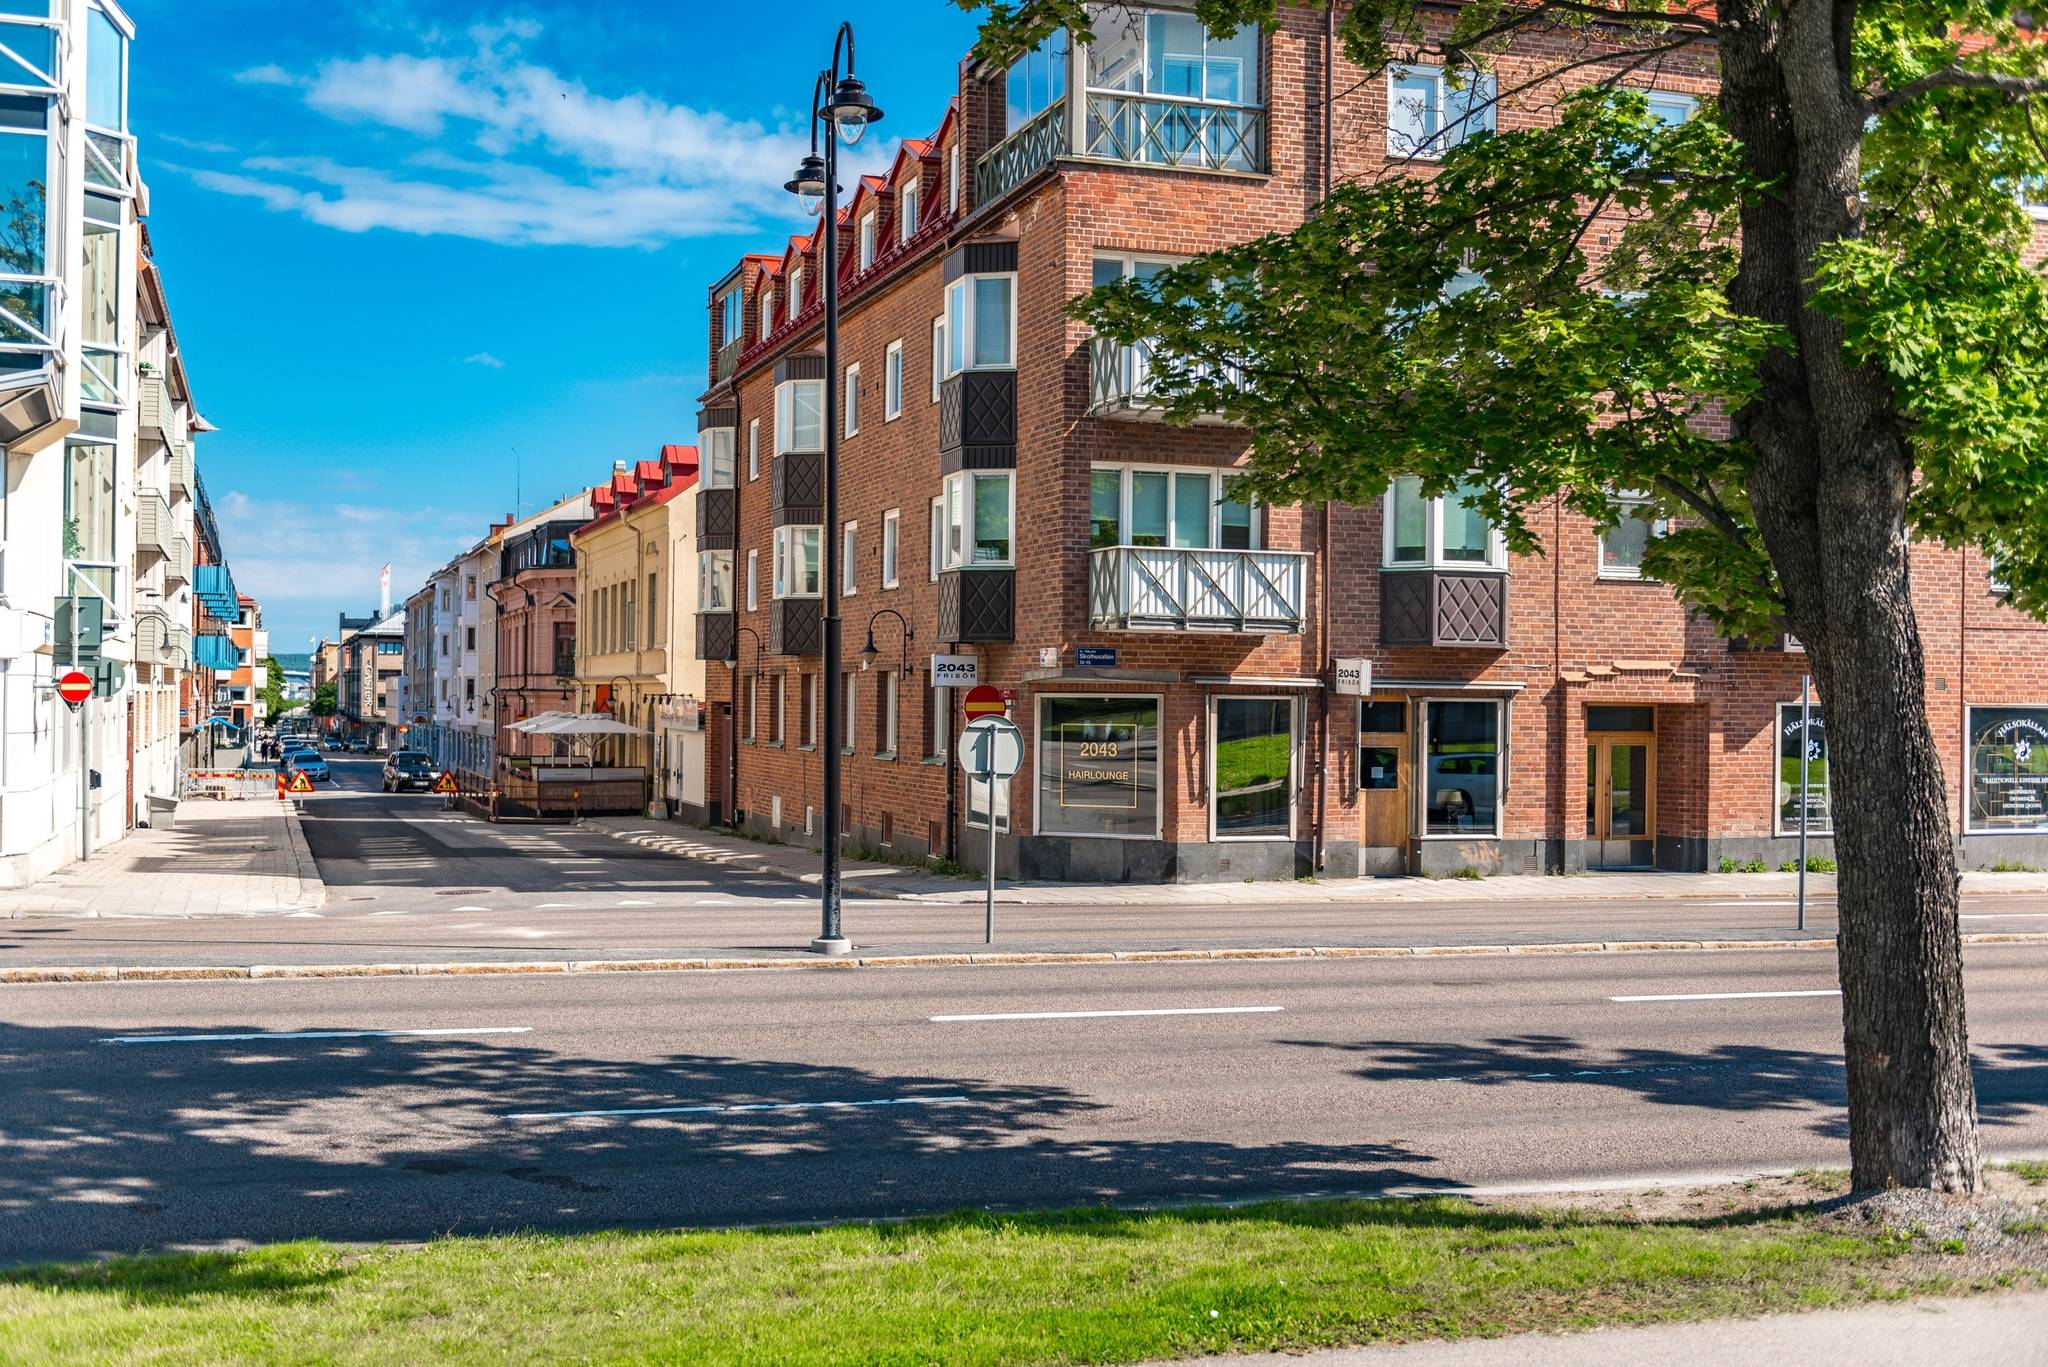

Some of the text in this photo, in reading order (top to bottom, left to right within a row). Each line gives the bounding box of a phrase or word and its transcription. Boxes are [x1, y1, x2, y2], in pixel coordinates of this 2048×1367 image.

[937, 663, 976, 672] 2043
[1338, 669, 1360, 678] 2043
[1998, 719, 2048, 738] HÄLSOKÄLLAN
[1080, 742, 1118, 757] 2043
[1068, 770, 1129, 780] HAIRLOUNGE
